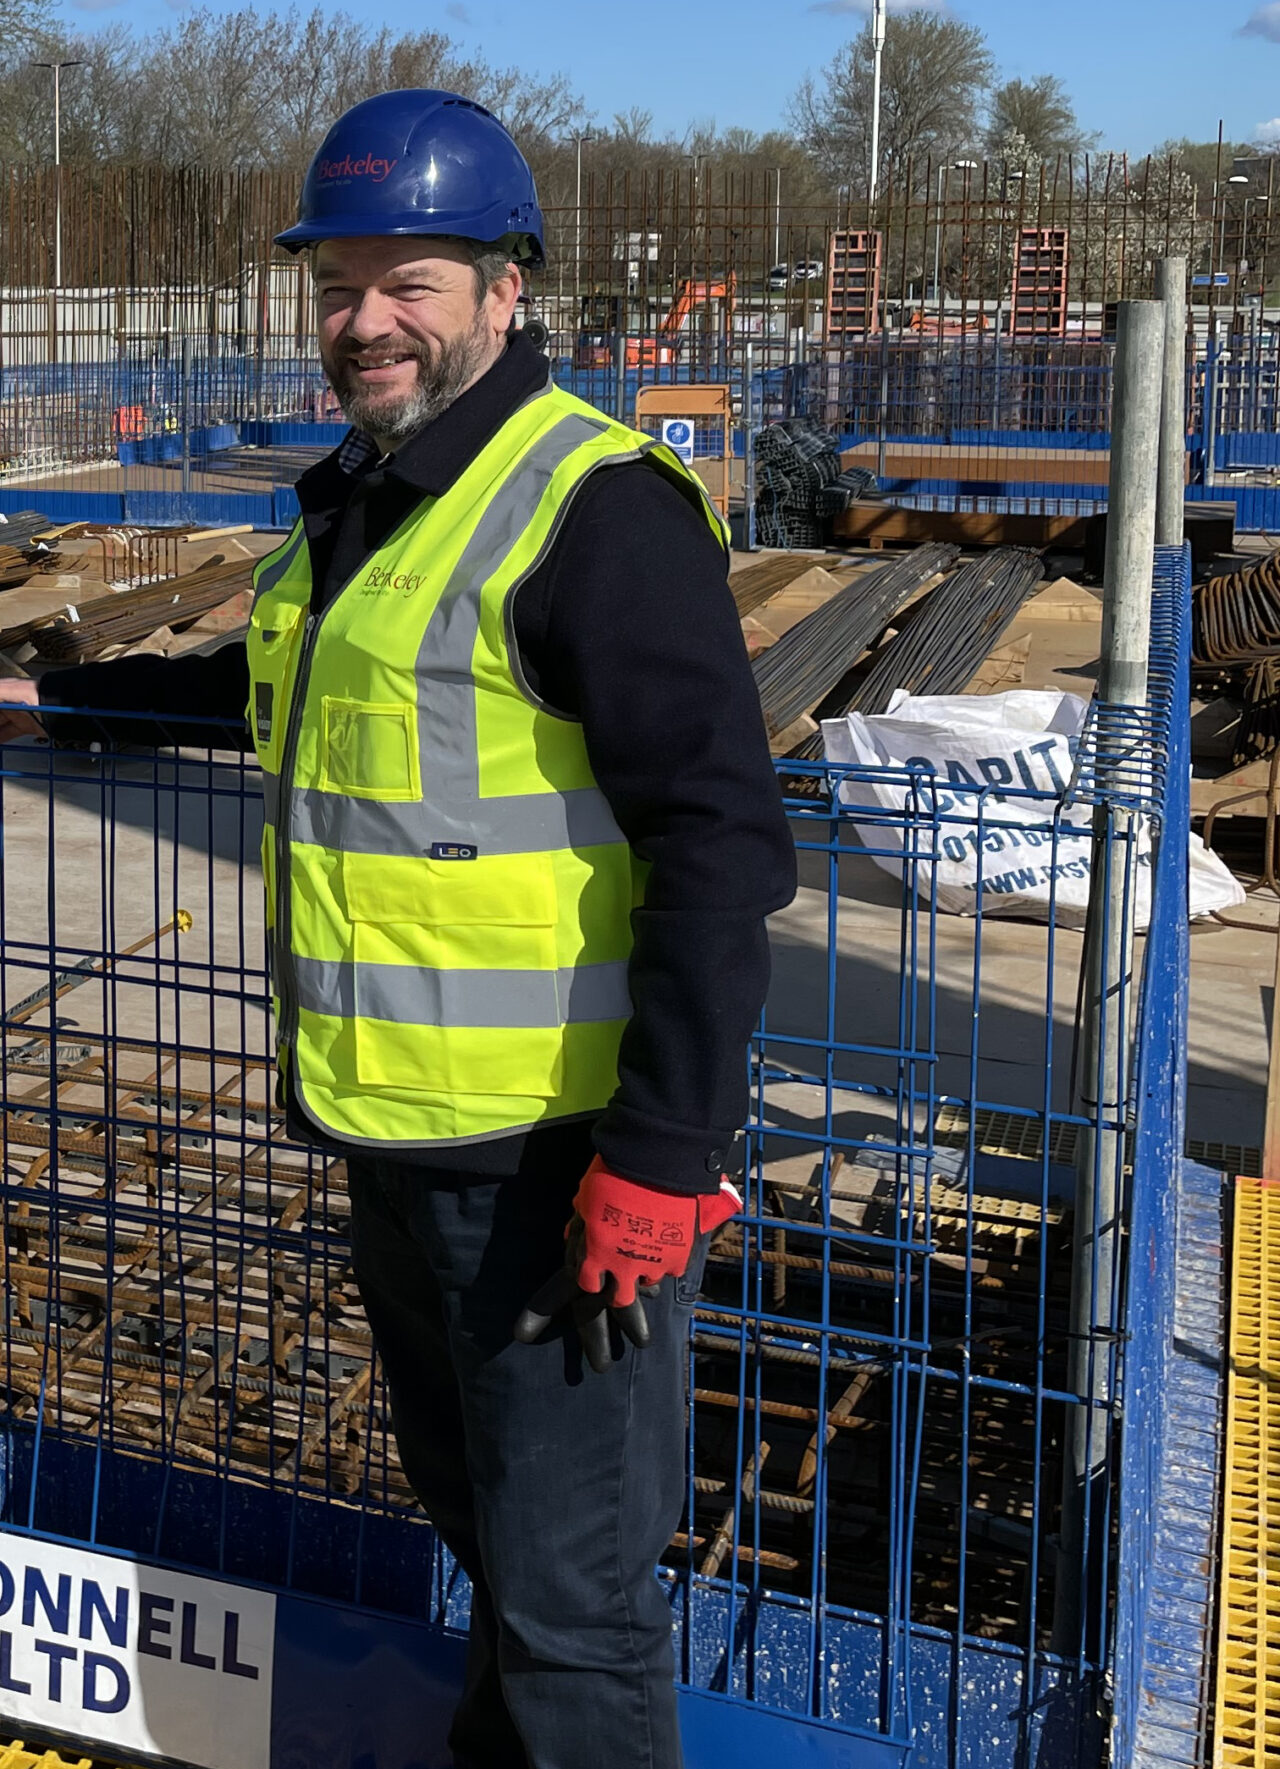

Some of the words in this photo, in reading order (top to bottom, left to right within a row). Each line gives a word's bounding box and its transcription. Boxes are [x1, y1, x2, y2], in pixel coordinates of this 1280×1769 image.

[319, 152, 399, 183] Berkeley
[364, 566, 428, 598] Berkeley
[439, 847, 471, 858] LEO
